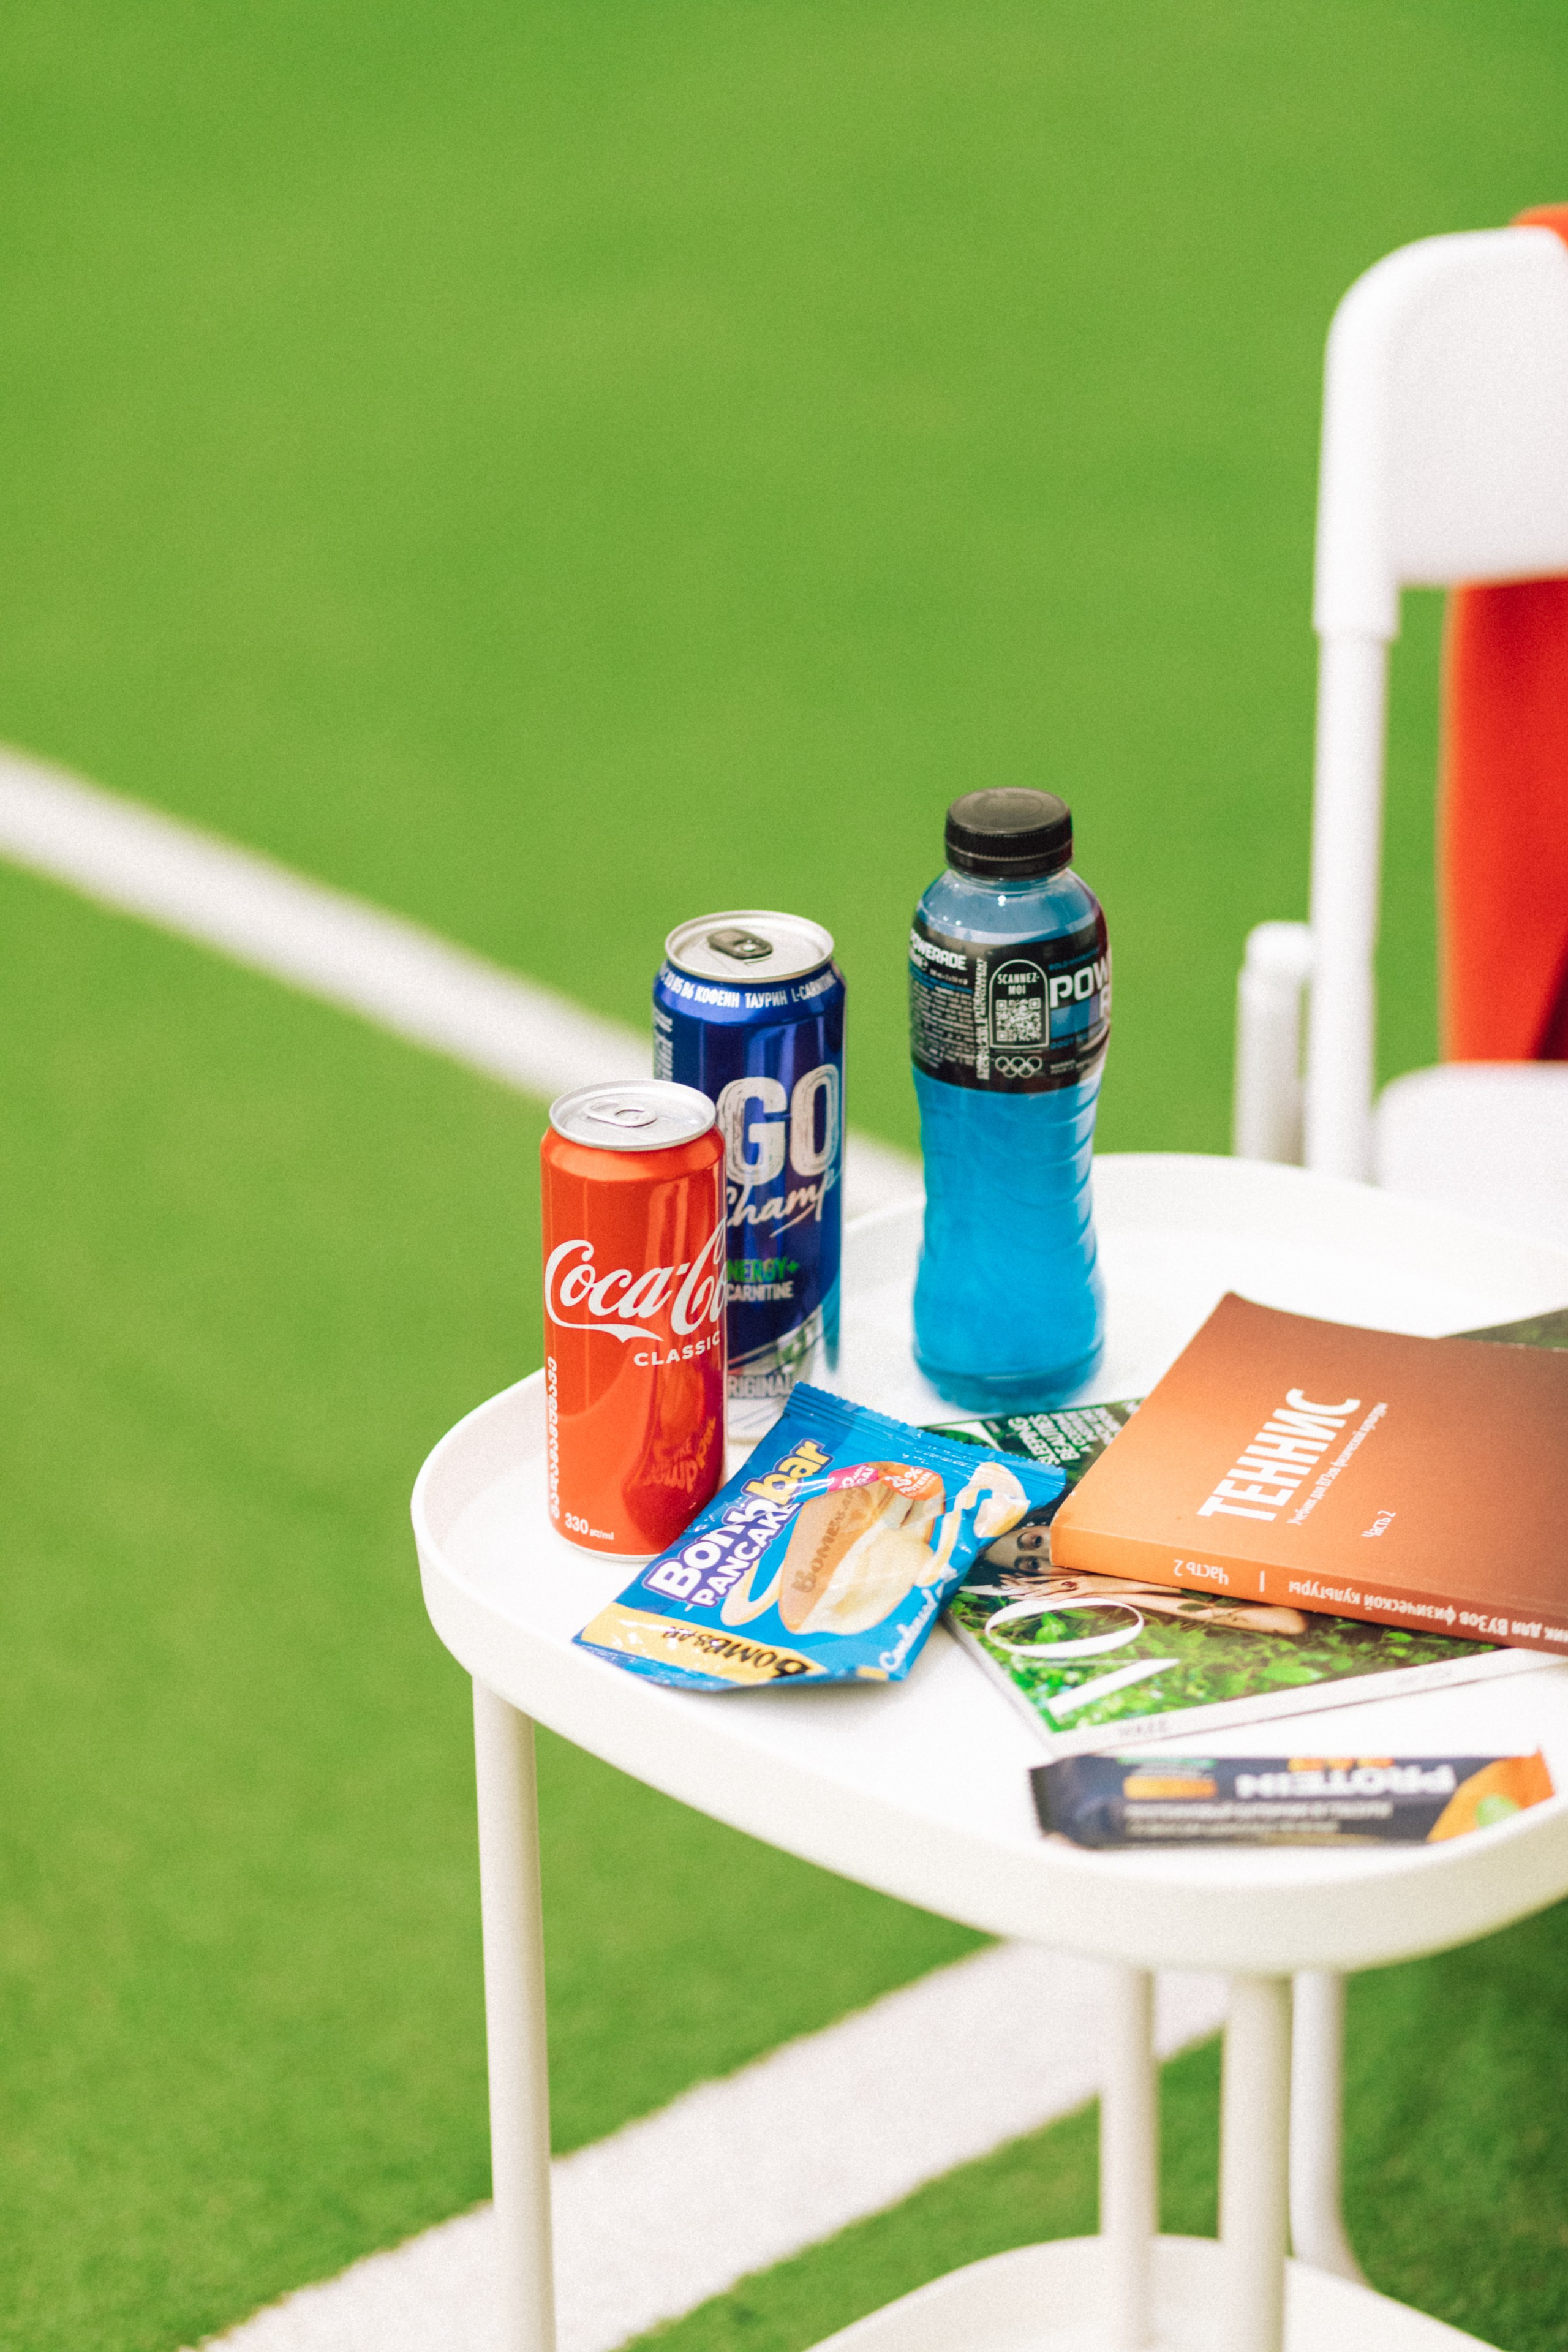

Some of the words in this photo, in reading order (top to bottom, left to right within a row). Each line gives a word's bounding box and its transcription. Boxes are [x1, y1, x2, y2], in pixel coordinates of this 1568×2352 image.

[694, 985, 741, 1008] КОФЕИН
[744, 989, 788, 1008] ТАУРИН
[1008, 985, 1027, 995] MOI
[716, 1063, 840, 1186] GO
[726, 1256, 799, 1283] NERGY+
[633, 1330, 720, 1366] CLASSIC
[727, 1374, 794, 1398] RIGINAL
[1007, 1415, 1061, 1465] SLEEPING
[1028, 1414, 1081, 1461] BEAUTIES
[1196, 1388, 1362, 1521] ТЕННИС
[565, 1512, 589, 1534] 330
[1286, 1498, 1318, 1526] Учебник
[1361, 1516, 1392, 1537] Часть
[1173, 1559, 1183, 1577] 2
[1186, 1562, 1229, 1586] Часть
[1288, 1580, 1361, 1605] культуры
[1363, 1594, 1457, 1626] физической
[1458, 1611, 1509, 1637] ВУЗов
